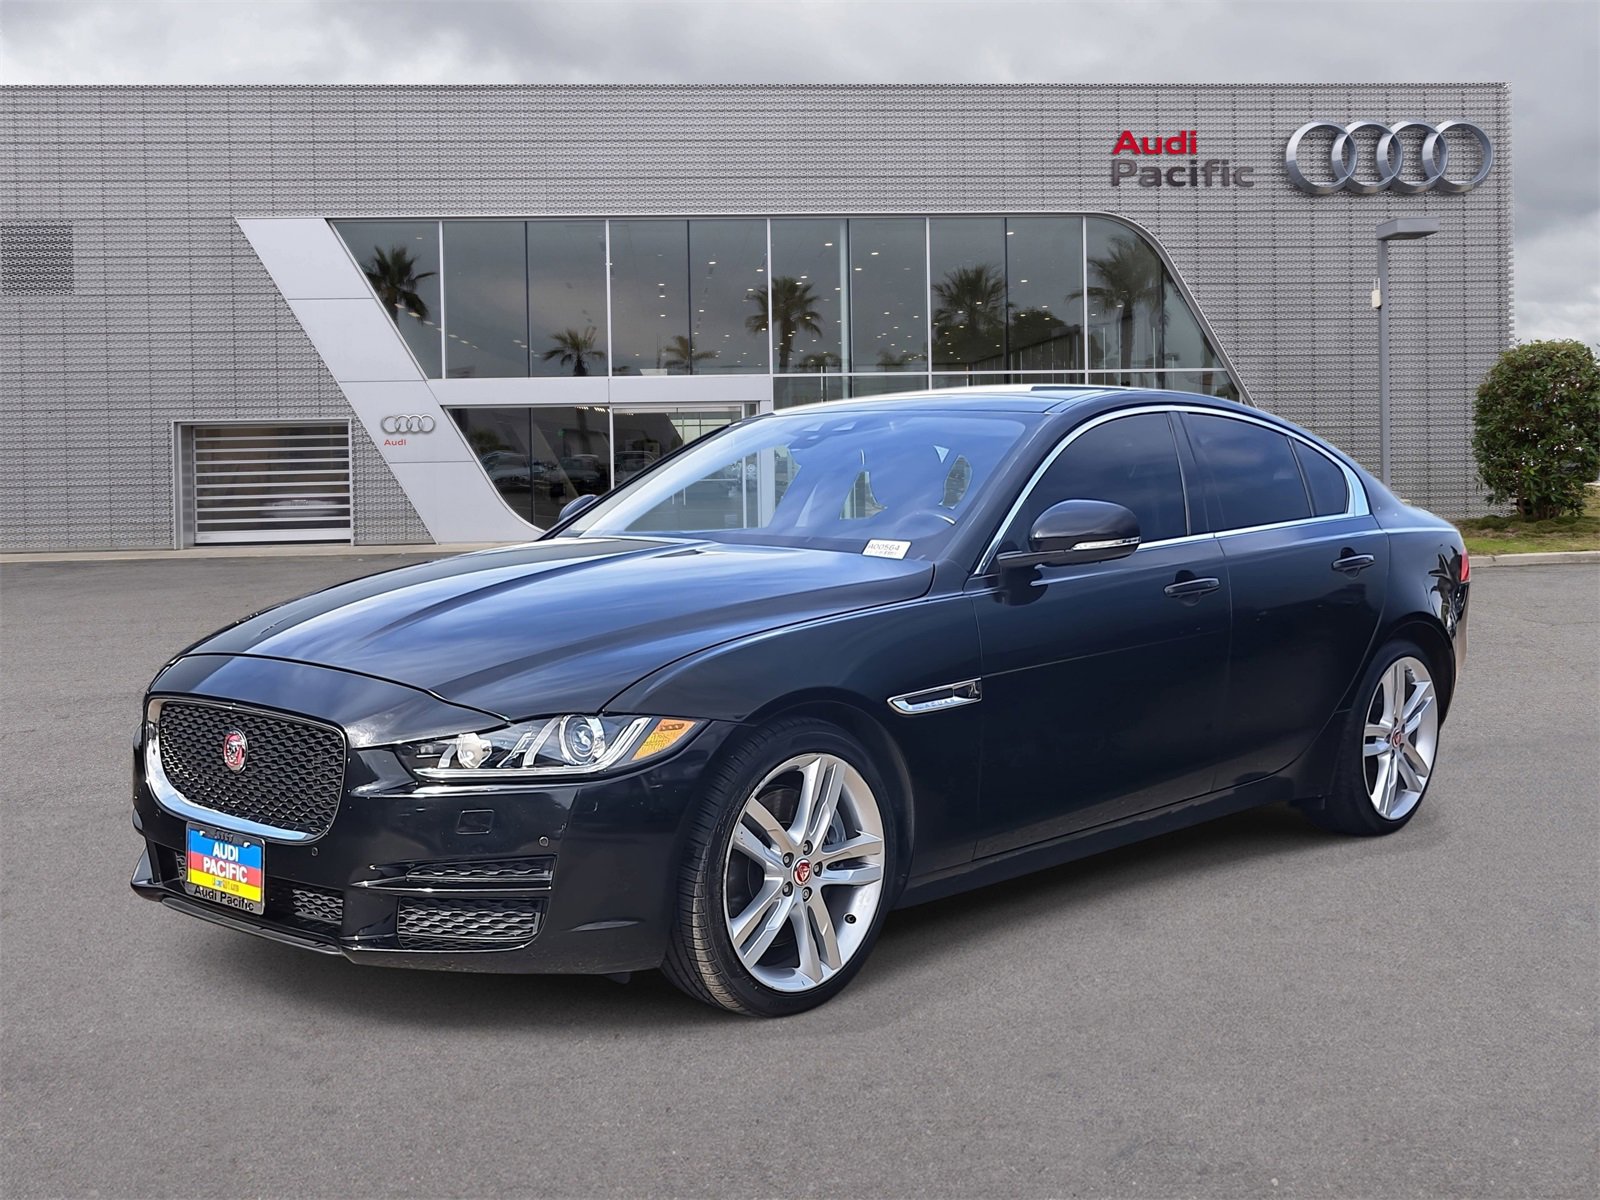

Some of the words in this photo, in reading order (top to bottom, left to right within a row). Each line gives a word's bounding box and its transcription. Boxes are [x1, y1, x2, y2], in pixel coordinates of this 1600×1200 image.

[1111, 130, 1197, 155] Audi
[1111, 159, 1255, 187] Pacific
[212, 841, 239, 862] AUDI
[203, 856, 248, 883] PACIFIC
[194, 885, 217, 901] Audi
[219, 891, 255, 911] Pacific
